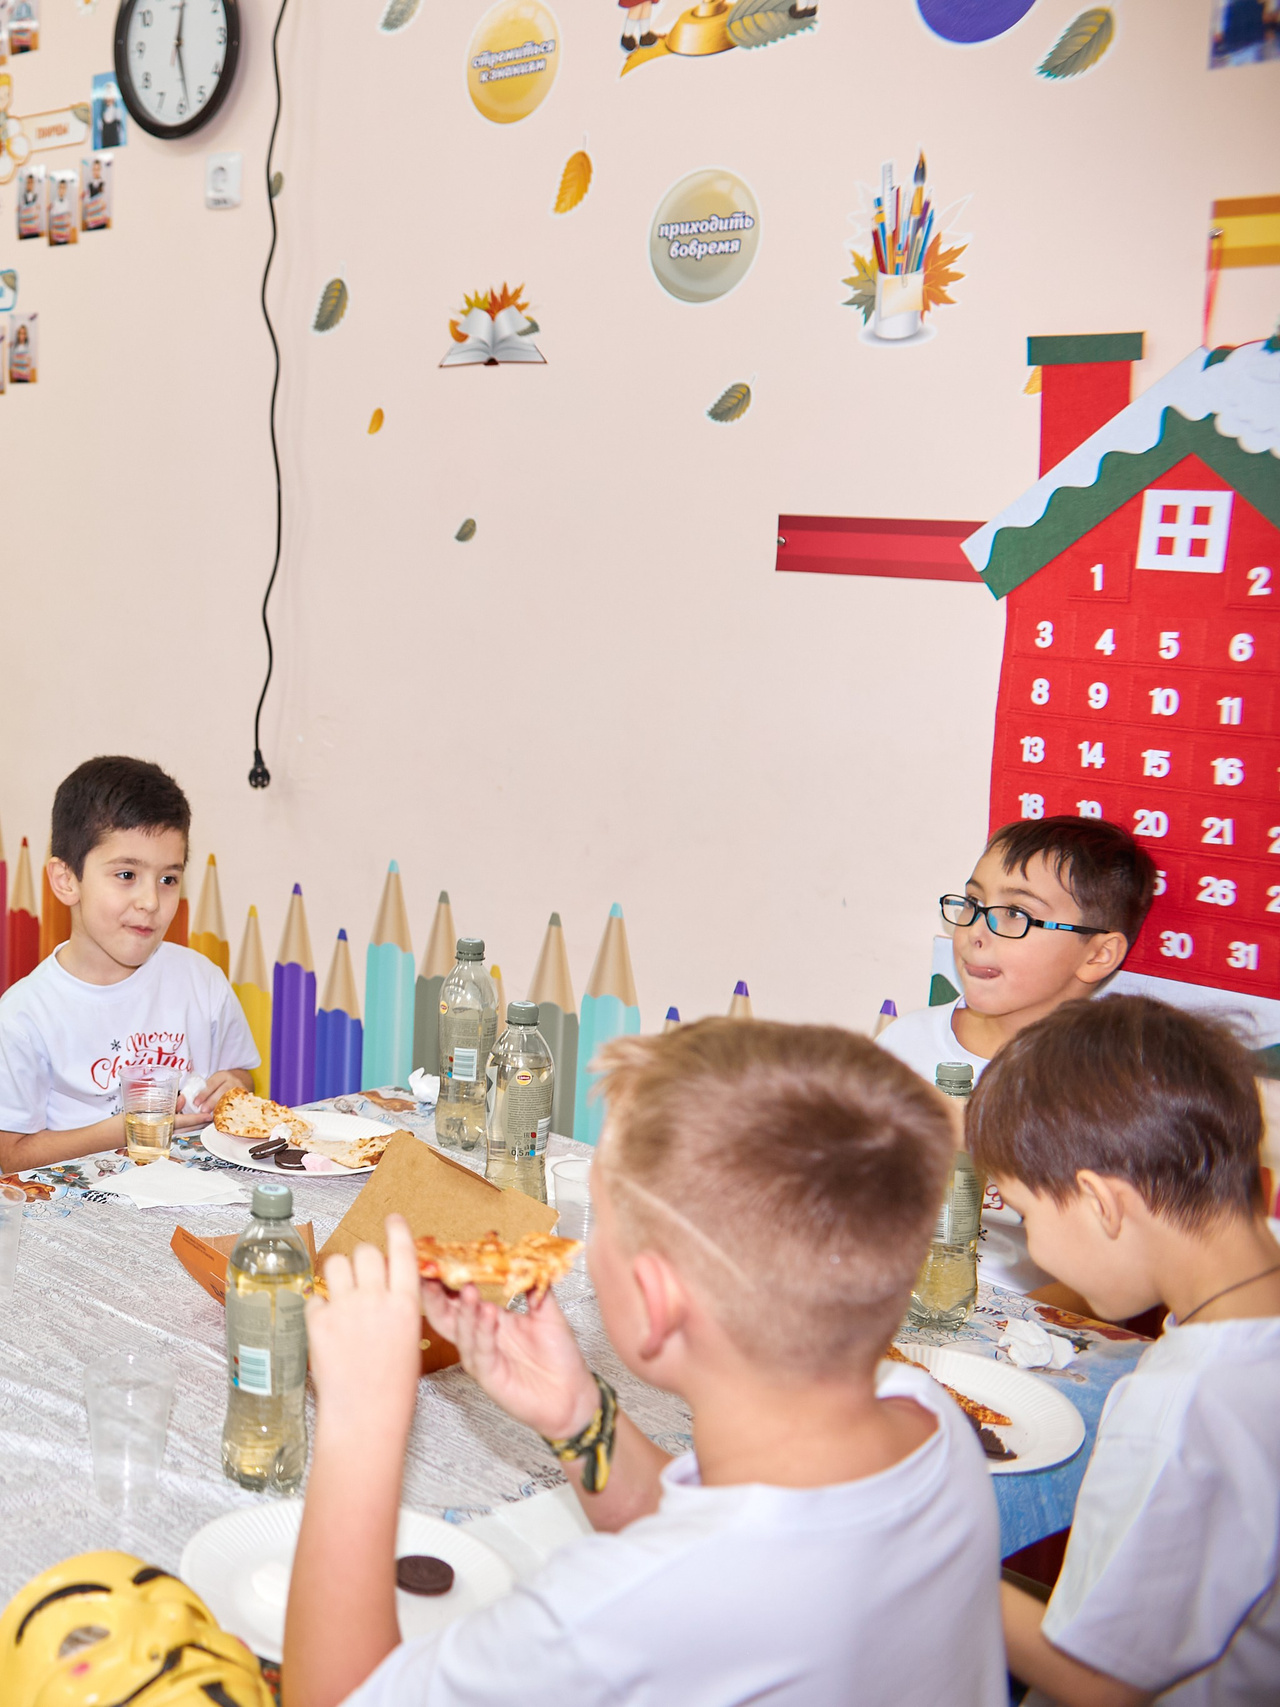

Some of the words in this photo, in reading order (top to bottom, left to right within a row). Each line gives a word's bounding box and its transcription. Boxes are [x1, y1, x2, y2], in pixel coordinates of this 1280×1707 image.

[138, 9, 153, 28] 10
[135, 41, 146, 59] 9
[141, 71, 152, 89] 8
[156, 91, 166, 112] 7
[176, 98, 187, 115] 6
[197, 85, 206, 104] 5
[658, 211, 755, 241] приходить
[668, 238, 742, 261] вовремя
[1089, 563, 1104, 592] 1
[1246, 566, 1272, 597] 2
[1034, 620, 1054, 649] 3
[1094, 628, 1116, 656] 4
[1158, 631, 1180, 660] 5
[1228, 632, 1255, 663] 6
[1030, 677, 1050, 706] 8
[1087, 681, 1109, 710] 9
[1148, 687, 1180, 717] 10
[1216, 696, 1244, 726] 11
[1019, 735, 1046, 764] 13
[1077, 740, 1106, 769] 14
[1141, 748, 1171, 778] 15
[1210, 757, 1245, 787] 16
[1018, 792, 1045, 821] 18
[1132, 808, 1169, 838] 20
[1200, 816, 1235, 846] 21
[1195, 875, 1238, 907] 26
[1158, 930, 1195, 960] 30
[1225, 941, 1260, 971] 31
[126, 1031, 185, 1056] Merry
